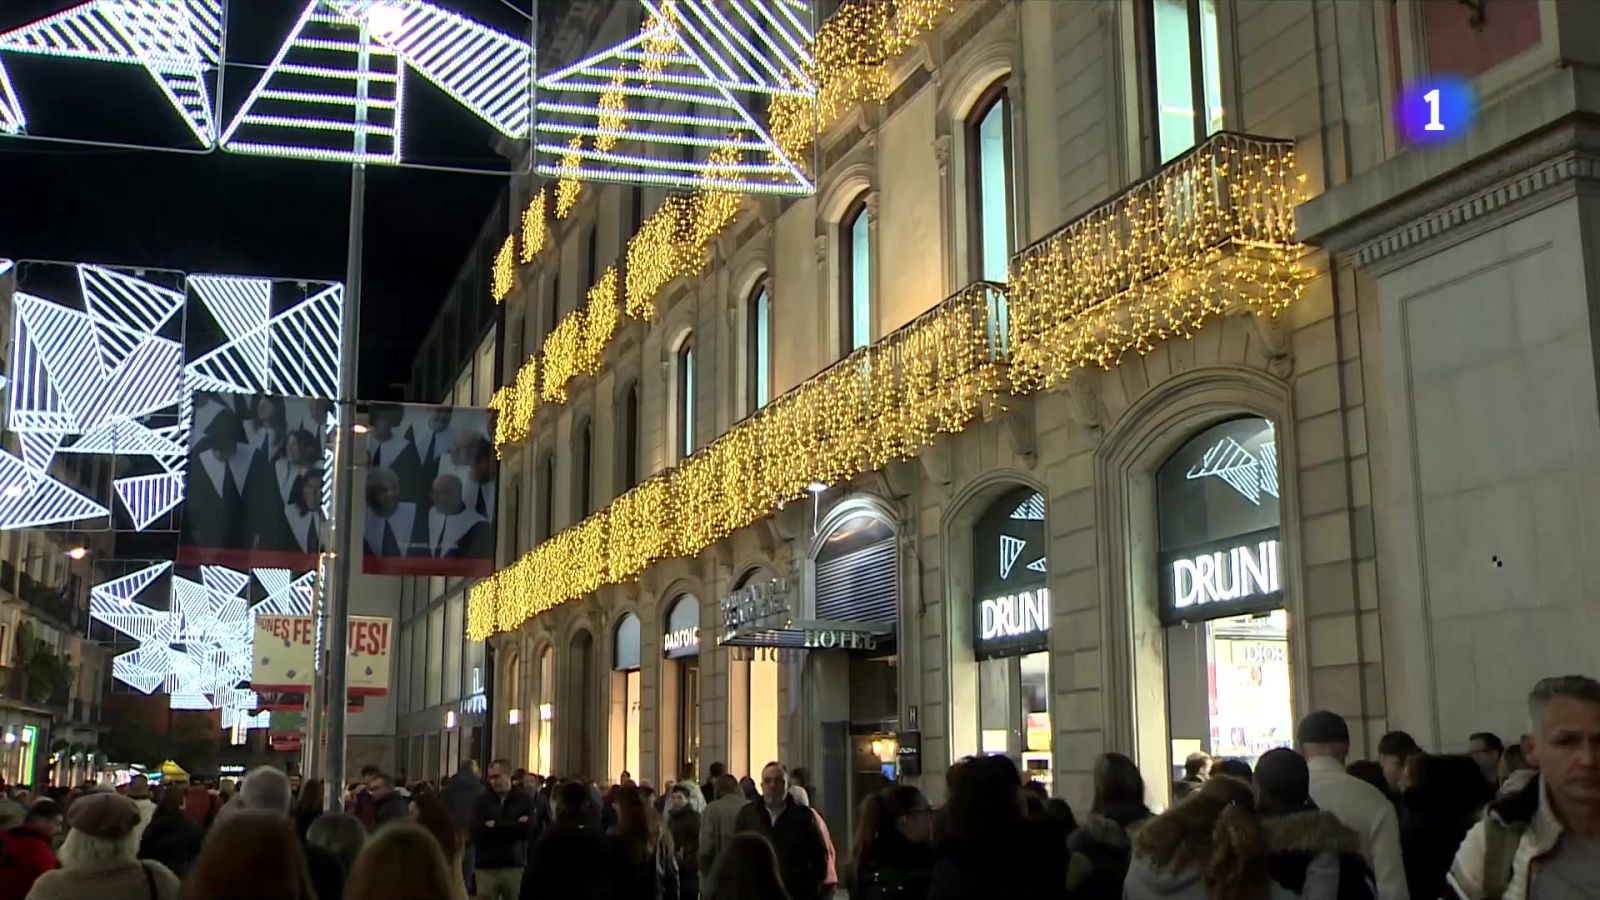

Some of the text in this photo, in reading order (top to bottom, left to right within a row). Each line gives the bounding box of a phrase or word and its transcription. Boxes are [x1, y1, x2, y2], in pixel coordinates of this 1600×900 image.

[1173, 539, 1280, 609] DRUNI
[804, 629, 876, 650] HOTEL
[981, 587, 1051, 640] DRUNI
